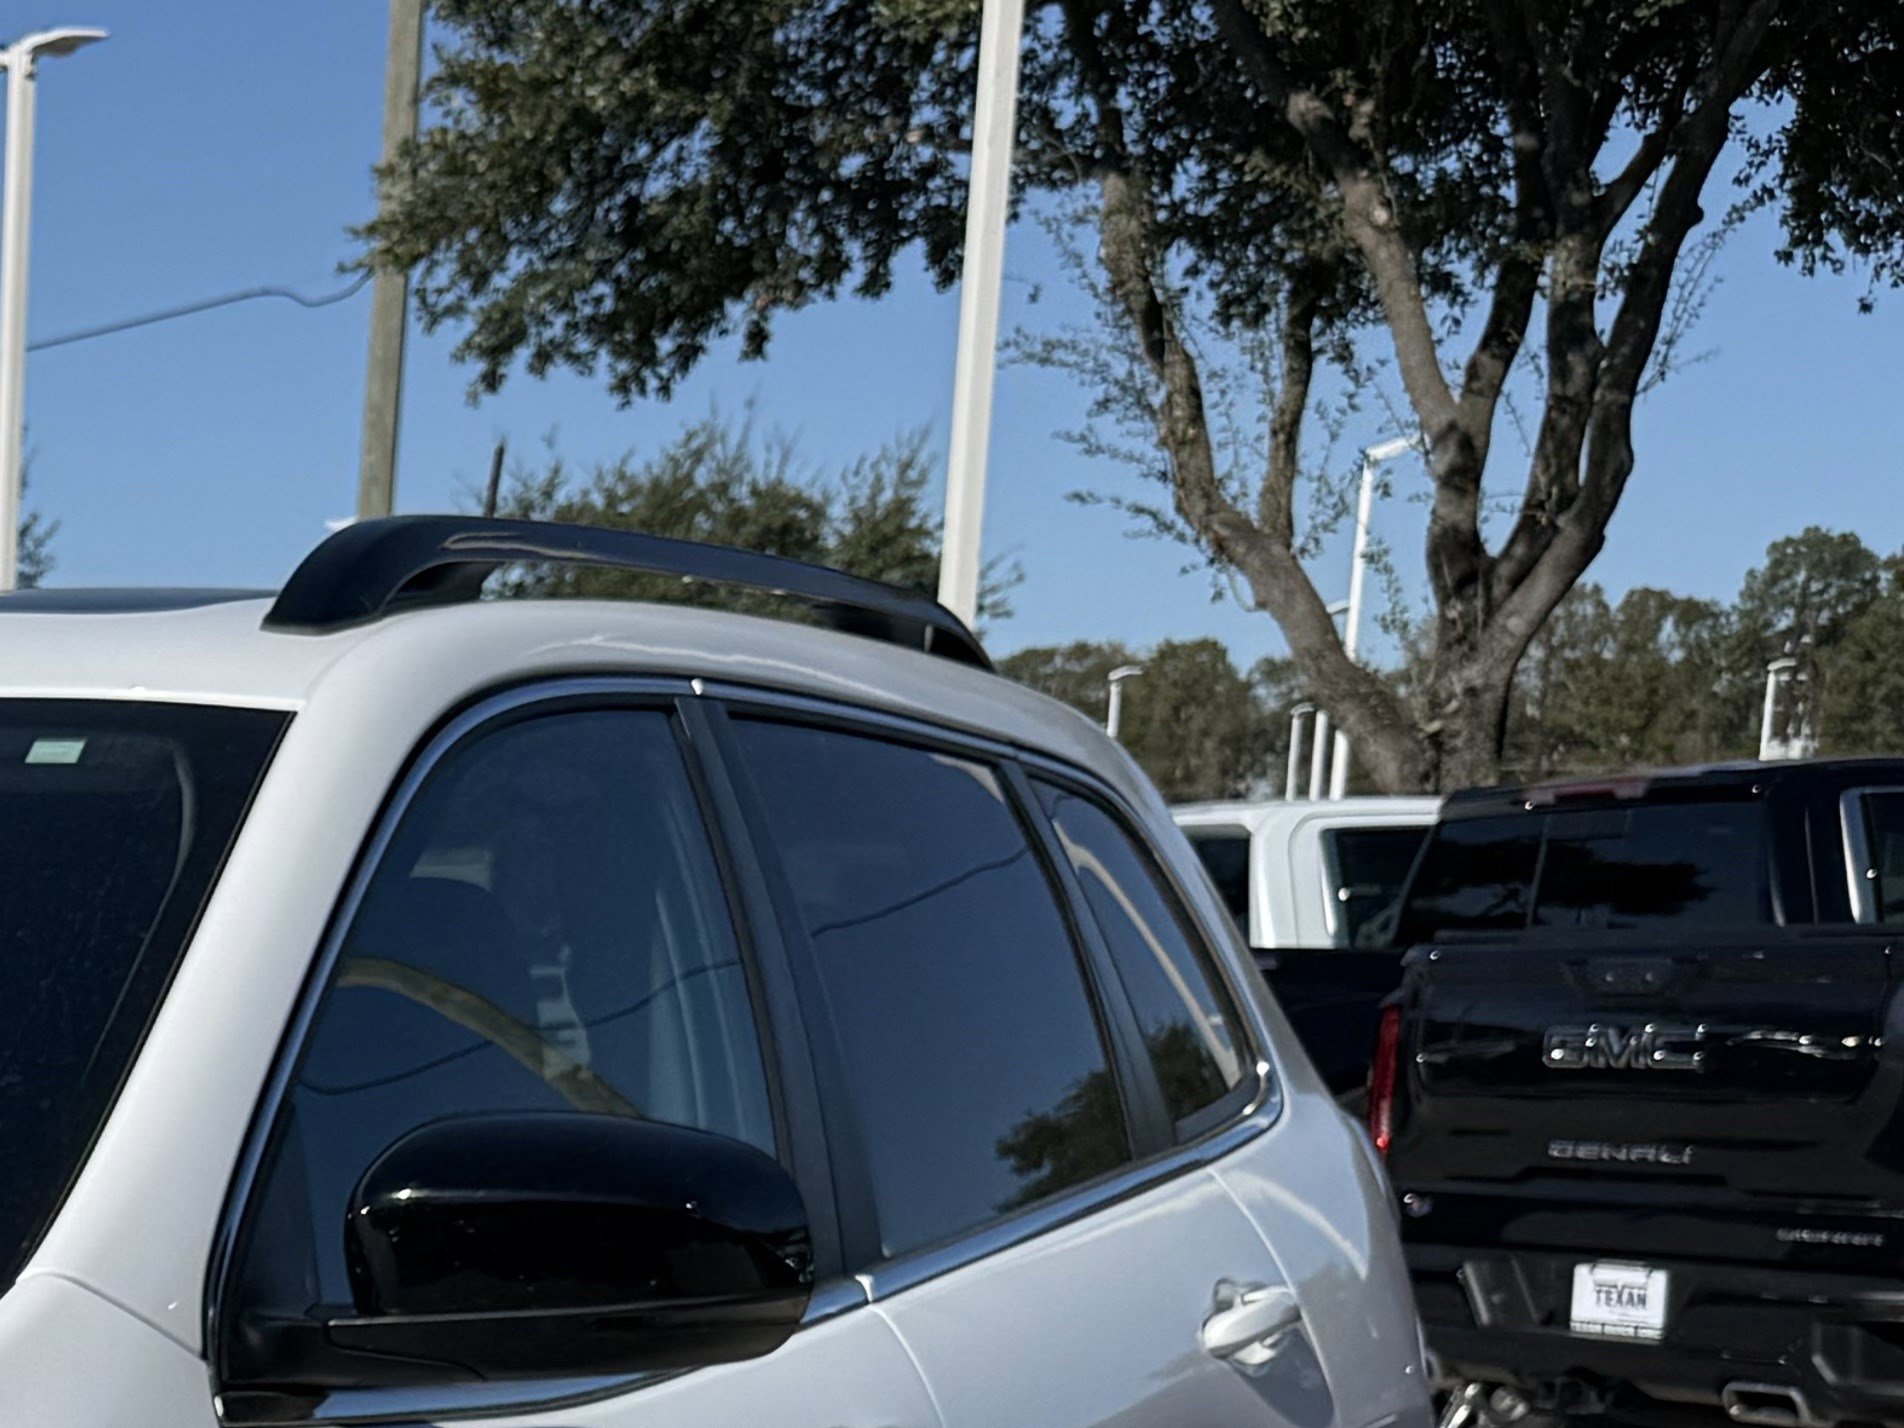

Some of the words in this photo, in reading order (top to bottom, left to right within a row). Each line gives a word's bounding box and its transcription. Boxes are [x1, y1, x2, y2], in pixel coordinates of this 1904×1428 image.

[1542, 1023, 1708, 1074] GMC
[1548, 1140, 1695, 1165] DENALI
[1595, 1285, 1647, 1309] TEXAN
